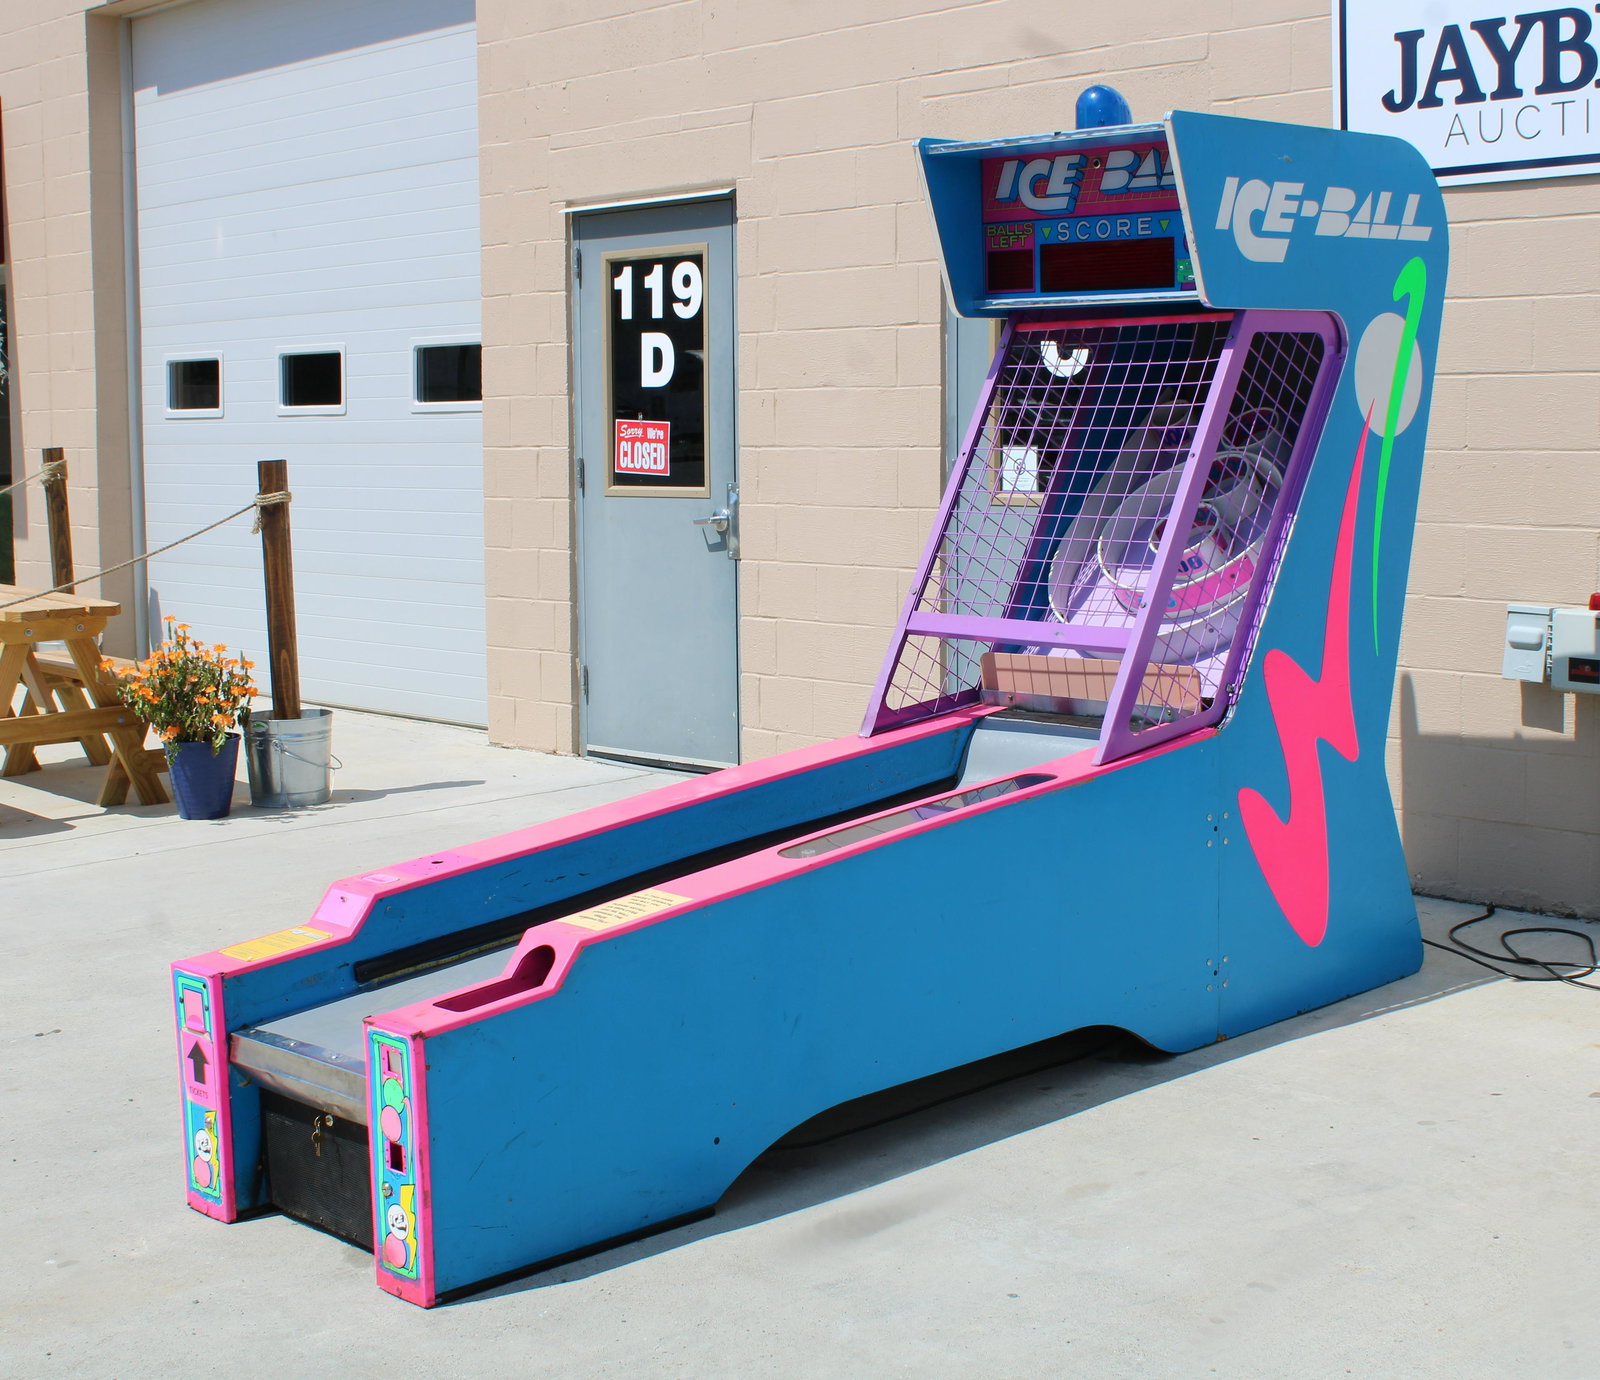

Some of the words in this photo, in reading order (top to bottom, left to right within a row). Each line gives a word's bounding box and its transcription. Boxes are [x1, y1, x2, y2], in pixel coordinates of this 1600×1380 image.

[1381, 3, 1600, 113] JAYB
[1444, 99, 1590, 148] AUCTI
[995, 154, 1087, 214] ICE
[987, 222, 1033, 237] BALLS
[991, 235, 1027, 248] LEFT
[1057, 217, 1152, 241] SCORE
[614, 261, 703, 320] 119
[641, 331, 675, 387] D
[620, 424, 644, 439] Sorry
[620, 440, 665, 470] CLOSED
